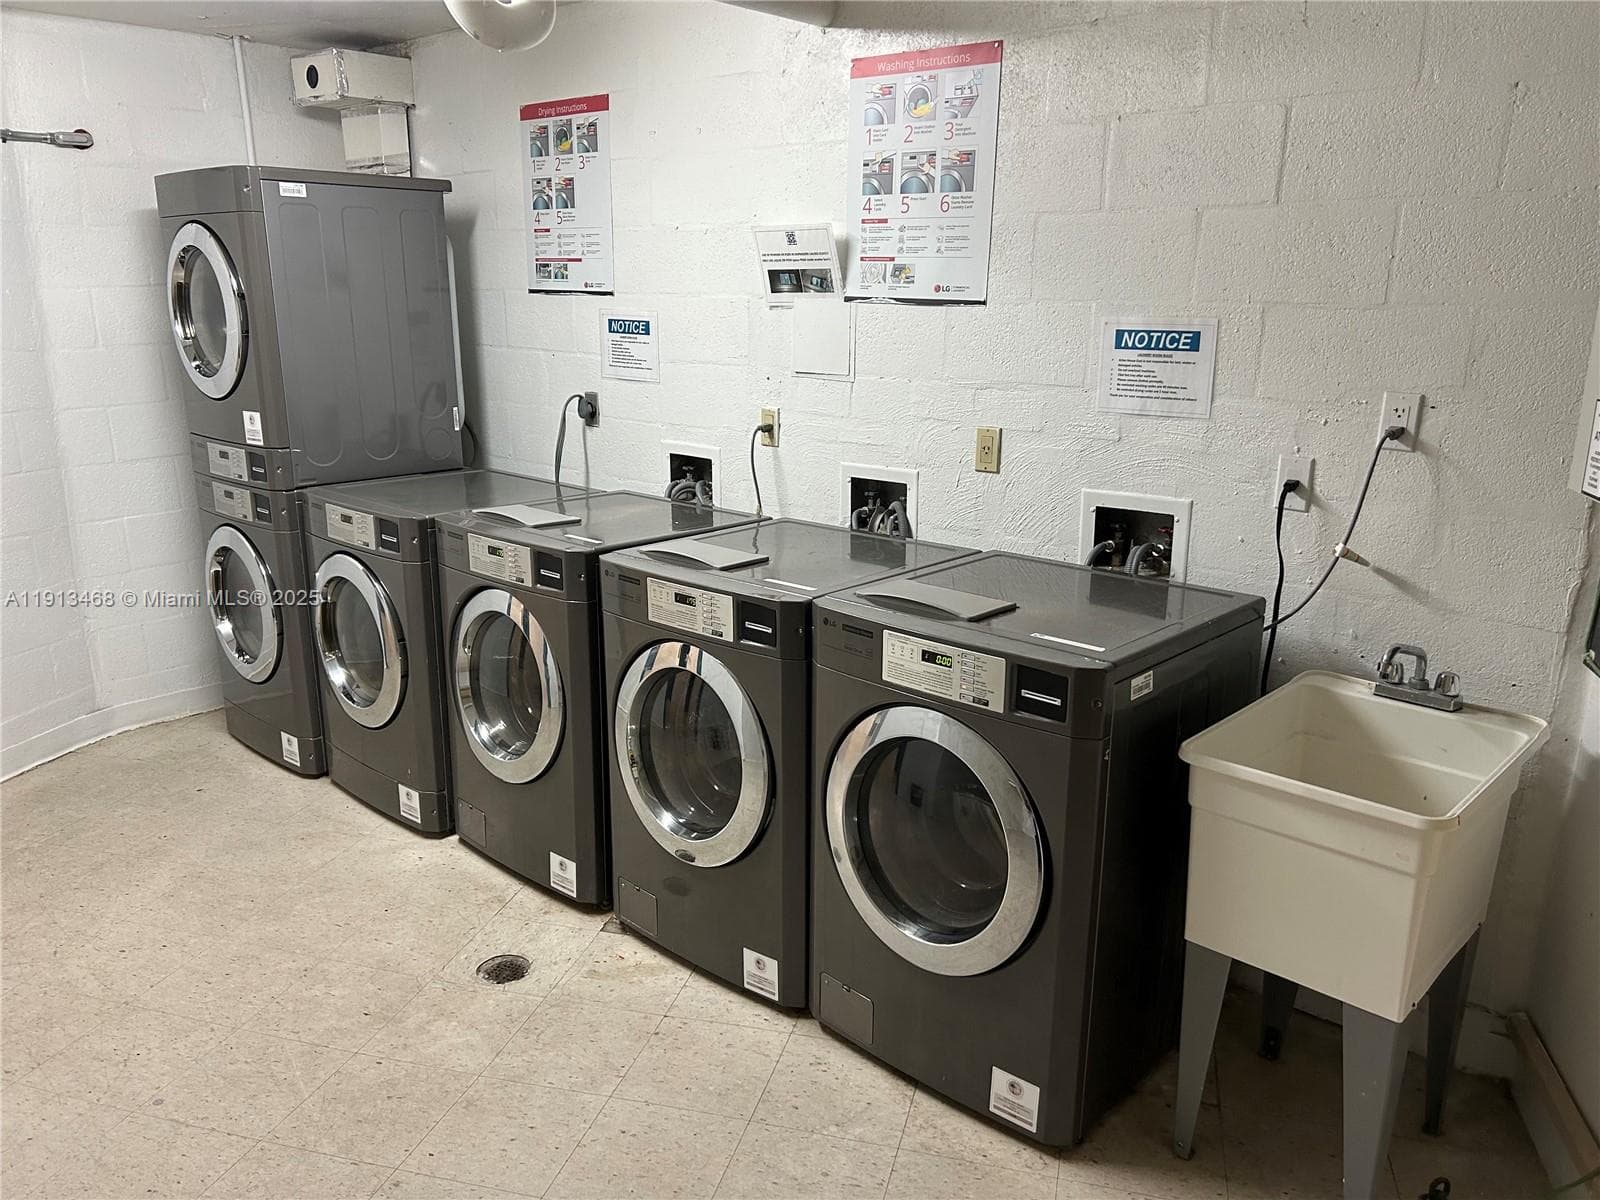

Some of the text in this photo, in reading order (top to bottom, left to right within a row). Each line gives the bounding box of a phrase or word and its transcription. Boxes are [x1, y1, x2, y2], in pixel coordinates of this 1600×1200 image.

[877, 53, 971, 73] Washing Instructions
[537, 103, 588, 118] Drying Instructions
[866, 128, 872, 145] 1
[904, 124, 913, 143] 2
[944, 122, 954, 141] 3
[555, 157, 561, 171] 2
[578, 155, 585, 169] 3
[863, 197, 872, 215] 4
[901, 196, 910, 214] 5
[940, 194, 950, 213] 6
[535, 212, 540, 224] 4
[557, 211, 563, 224] 5
[611, 320, 646, 333] NOTICE
[1121, 331, 1193, 349] NOTICE
